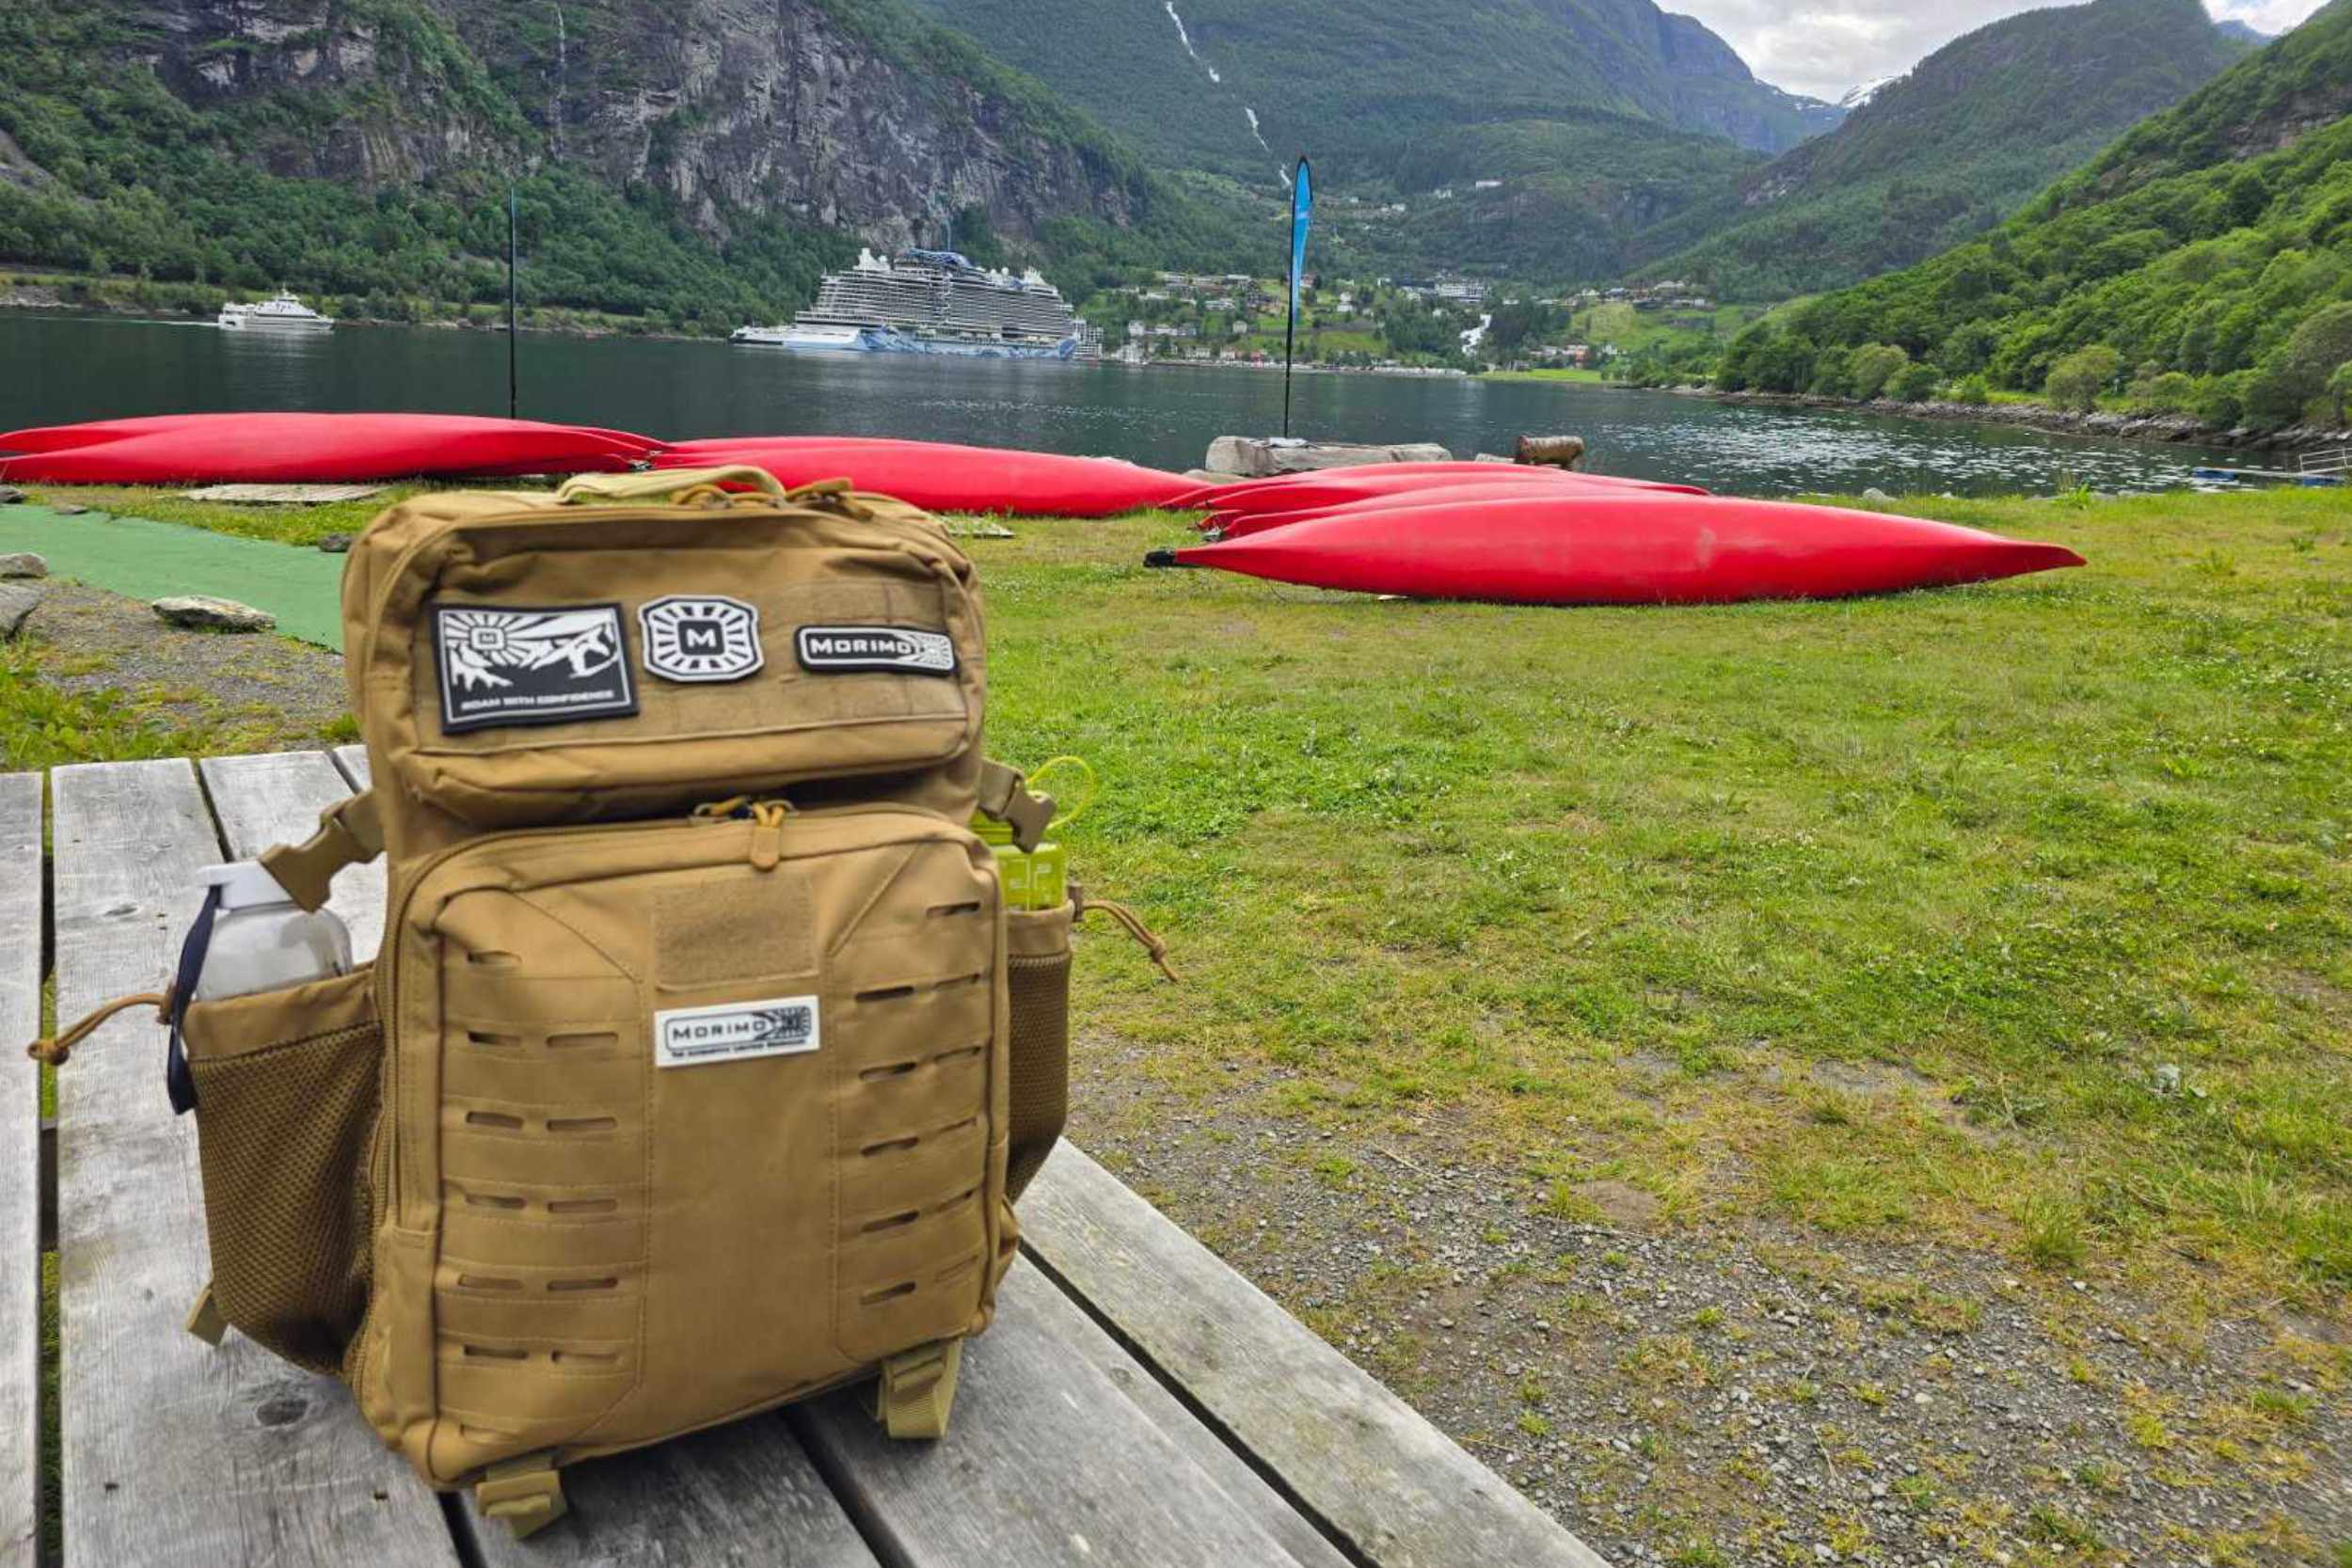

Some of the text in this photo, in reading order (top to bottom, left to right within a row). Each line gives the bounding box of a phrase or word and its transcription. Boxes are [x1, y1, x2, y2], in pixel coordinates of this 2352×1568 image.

[686, 627, 717, 648] M
[809, 637, 912, 655] MORIMO
[673, 1020, 767, 1040] MORIMO
